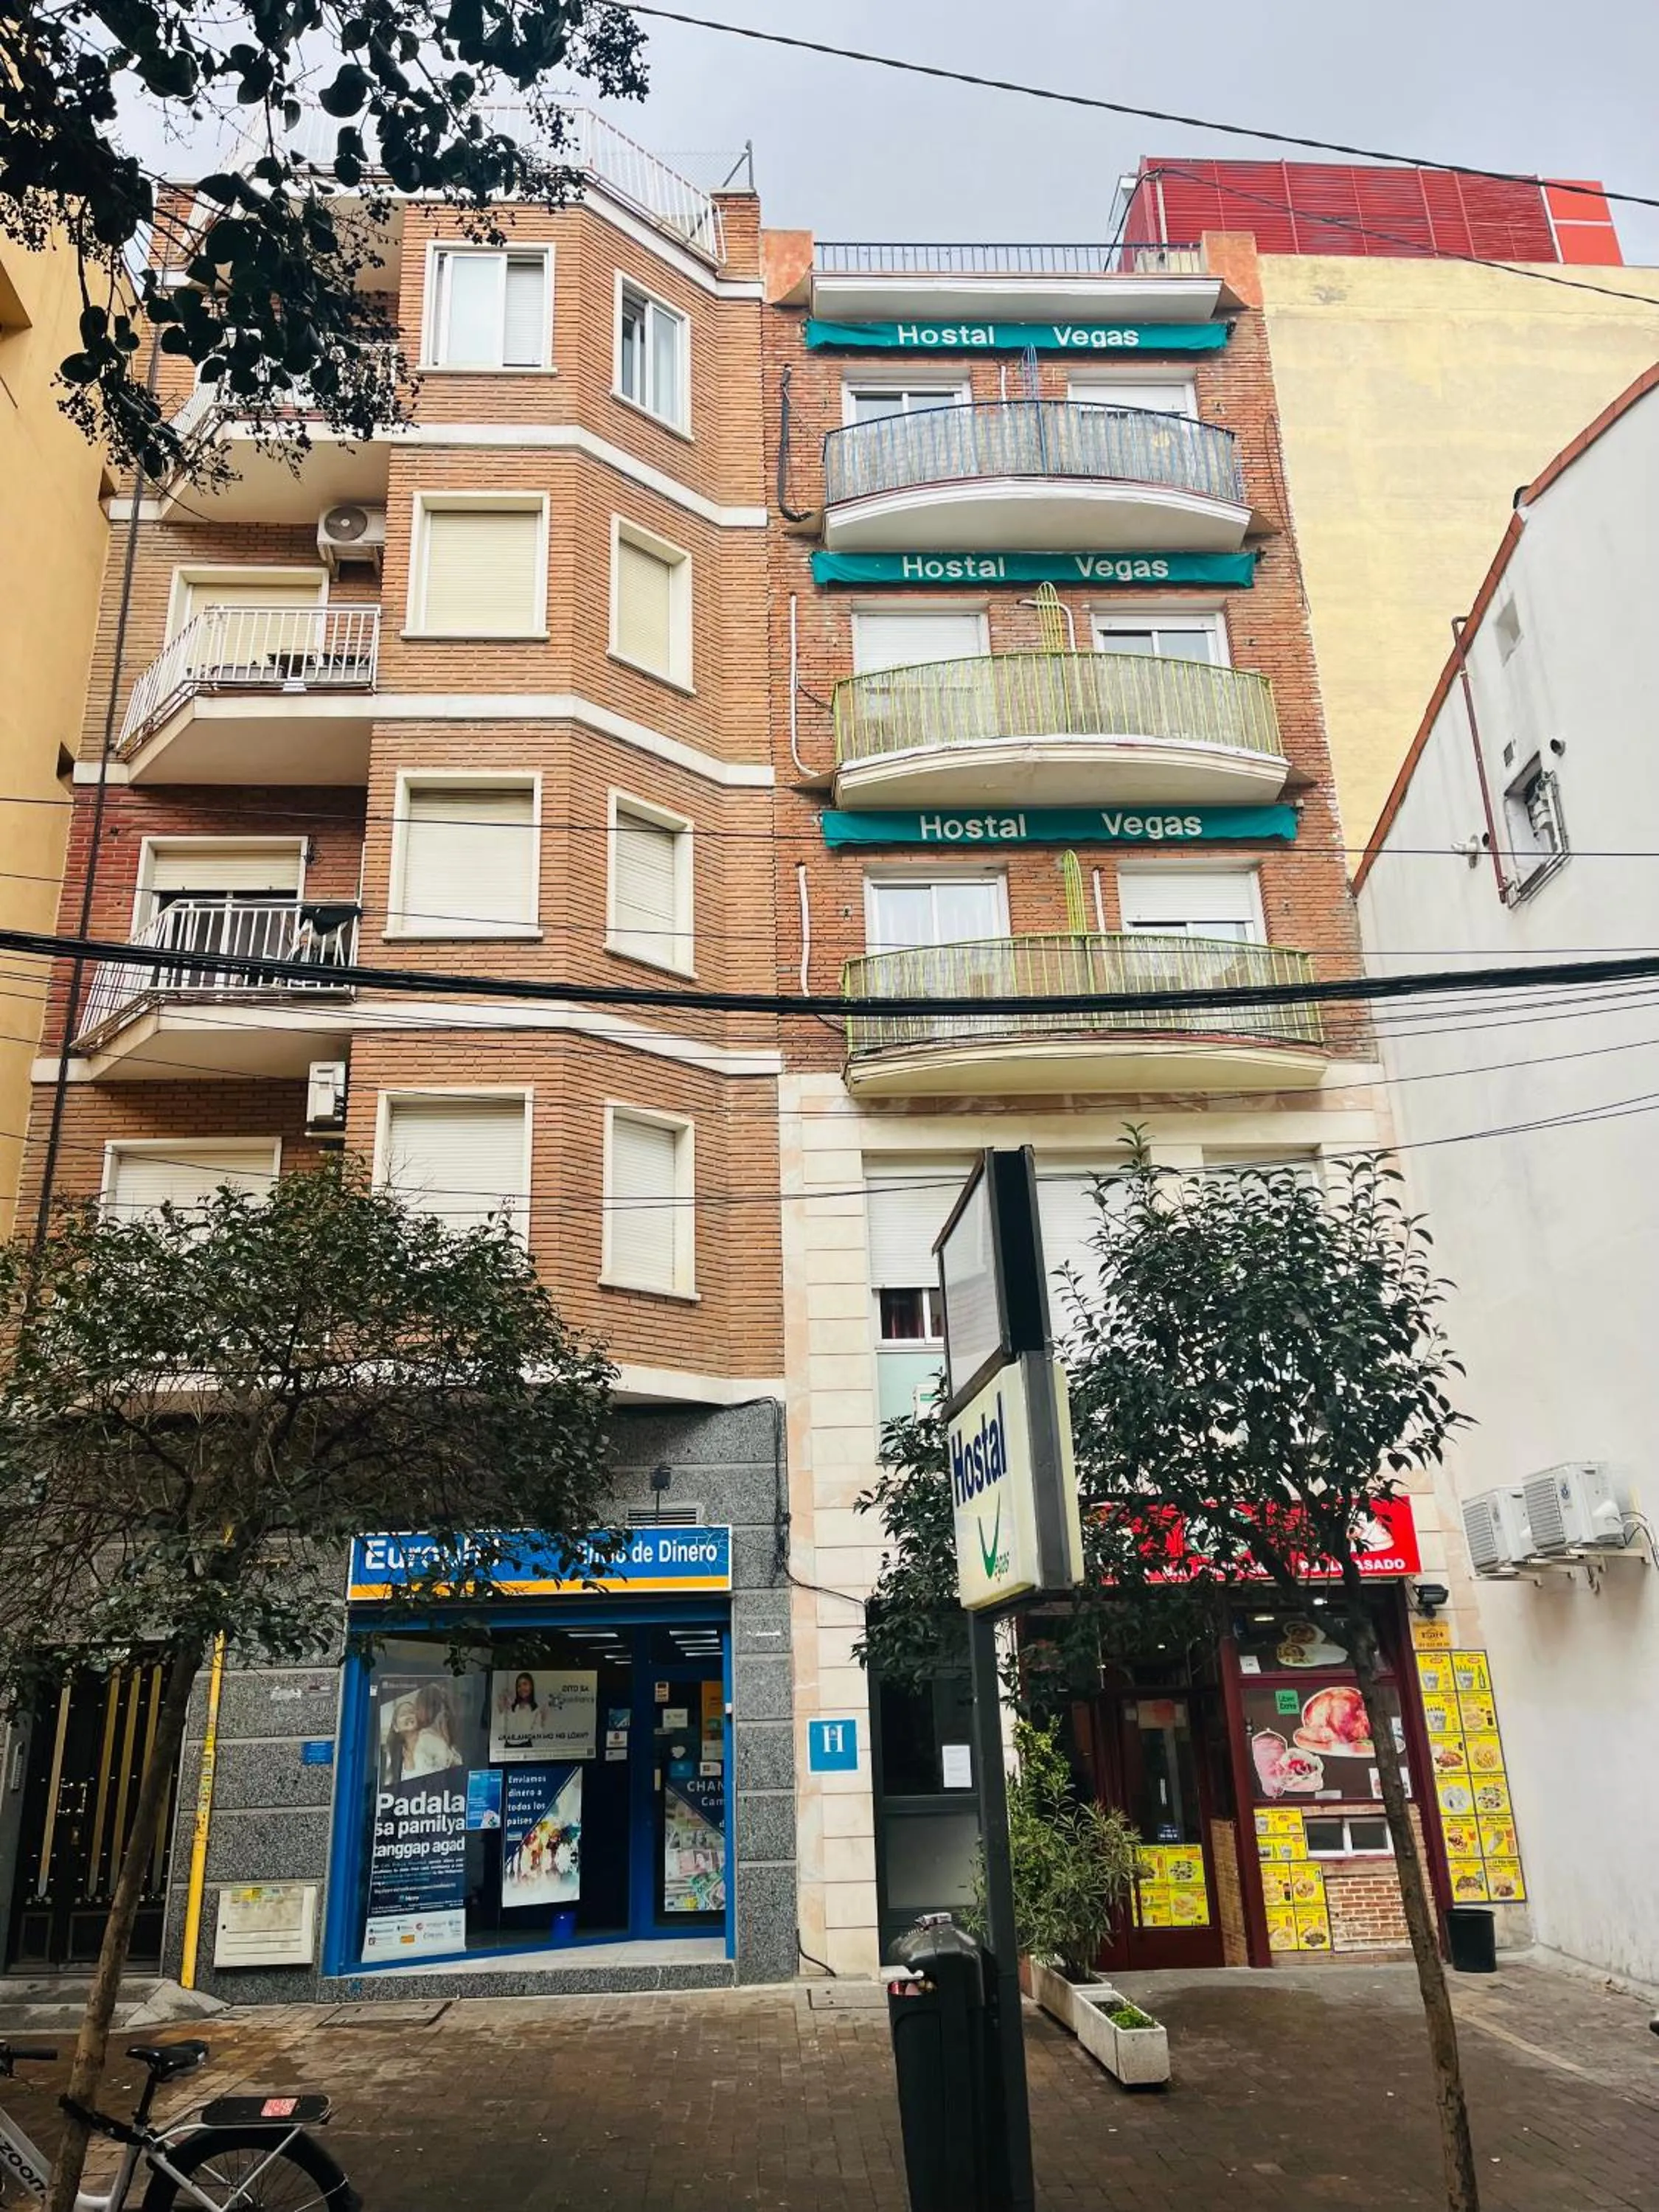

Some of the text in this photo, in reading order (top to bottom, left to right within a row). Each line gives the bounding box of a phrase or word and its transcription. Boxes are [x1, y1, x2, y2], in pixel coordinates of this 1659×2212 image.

[897, 325, 1140, 348] Hostal Vegas
[902, 557, 1169, 581] Hostal Vegas
[920, 813, 1203, 840] Hostal Vegas
[951, 1391, 1007, 1508] Hostal
[632, 1541, 653, 1563] de
[658, 1540, 718, 1563] Dinero
[1354, 1558, 1407, 1571] ASADO
[375, 1790, 466, 1818] Padala
[375, 1815, 466, 1840] sa pamilya
[432, 1835, 466, 1856] agad
